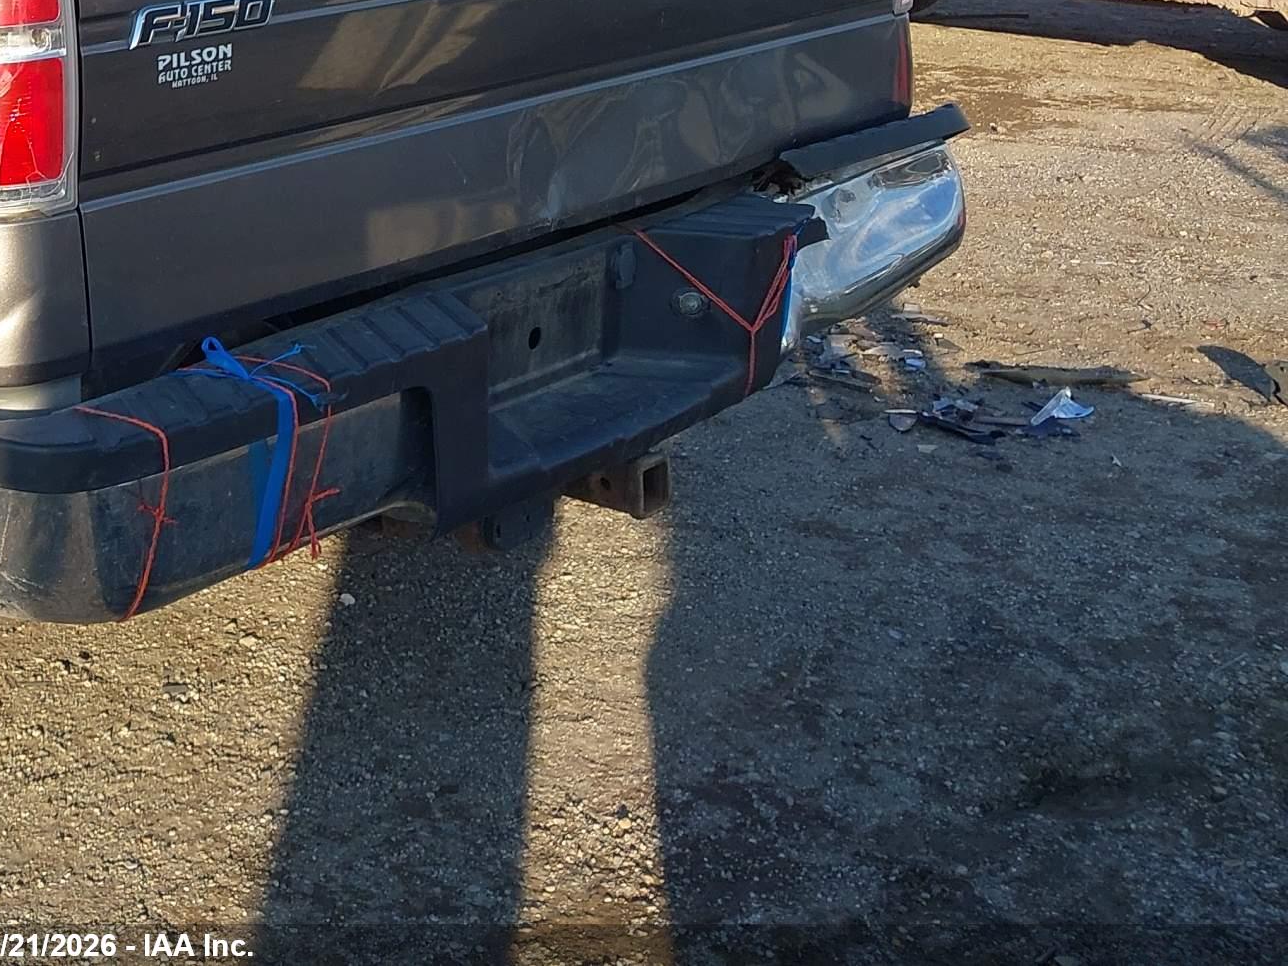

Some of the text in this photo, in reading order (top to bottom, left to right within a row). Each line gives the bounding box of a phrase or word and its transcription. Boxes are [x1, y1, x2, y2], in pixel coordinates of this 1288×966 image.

[158, 43, 232, 71] PILSON
[158, 59, 232, 84] AUTO CENTER
[211, 73, 218, 81] IL
